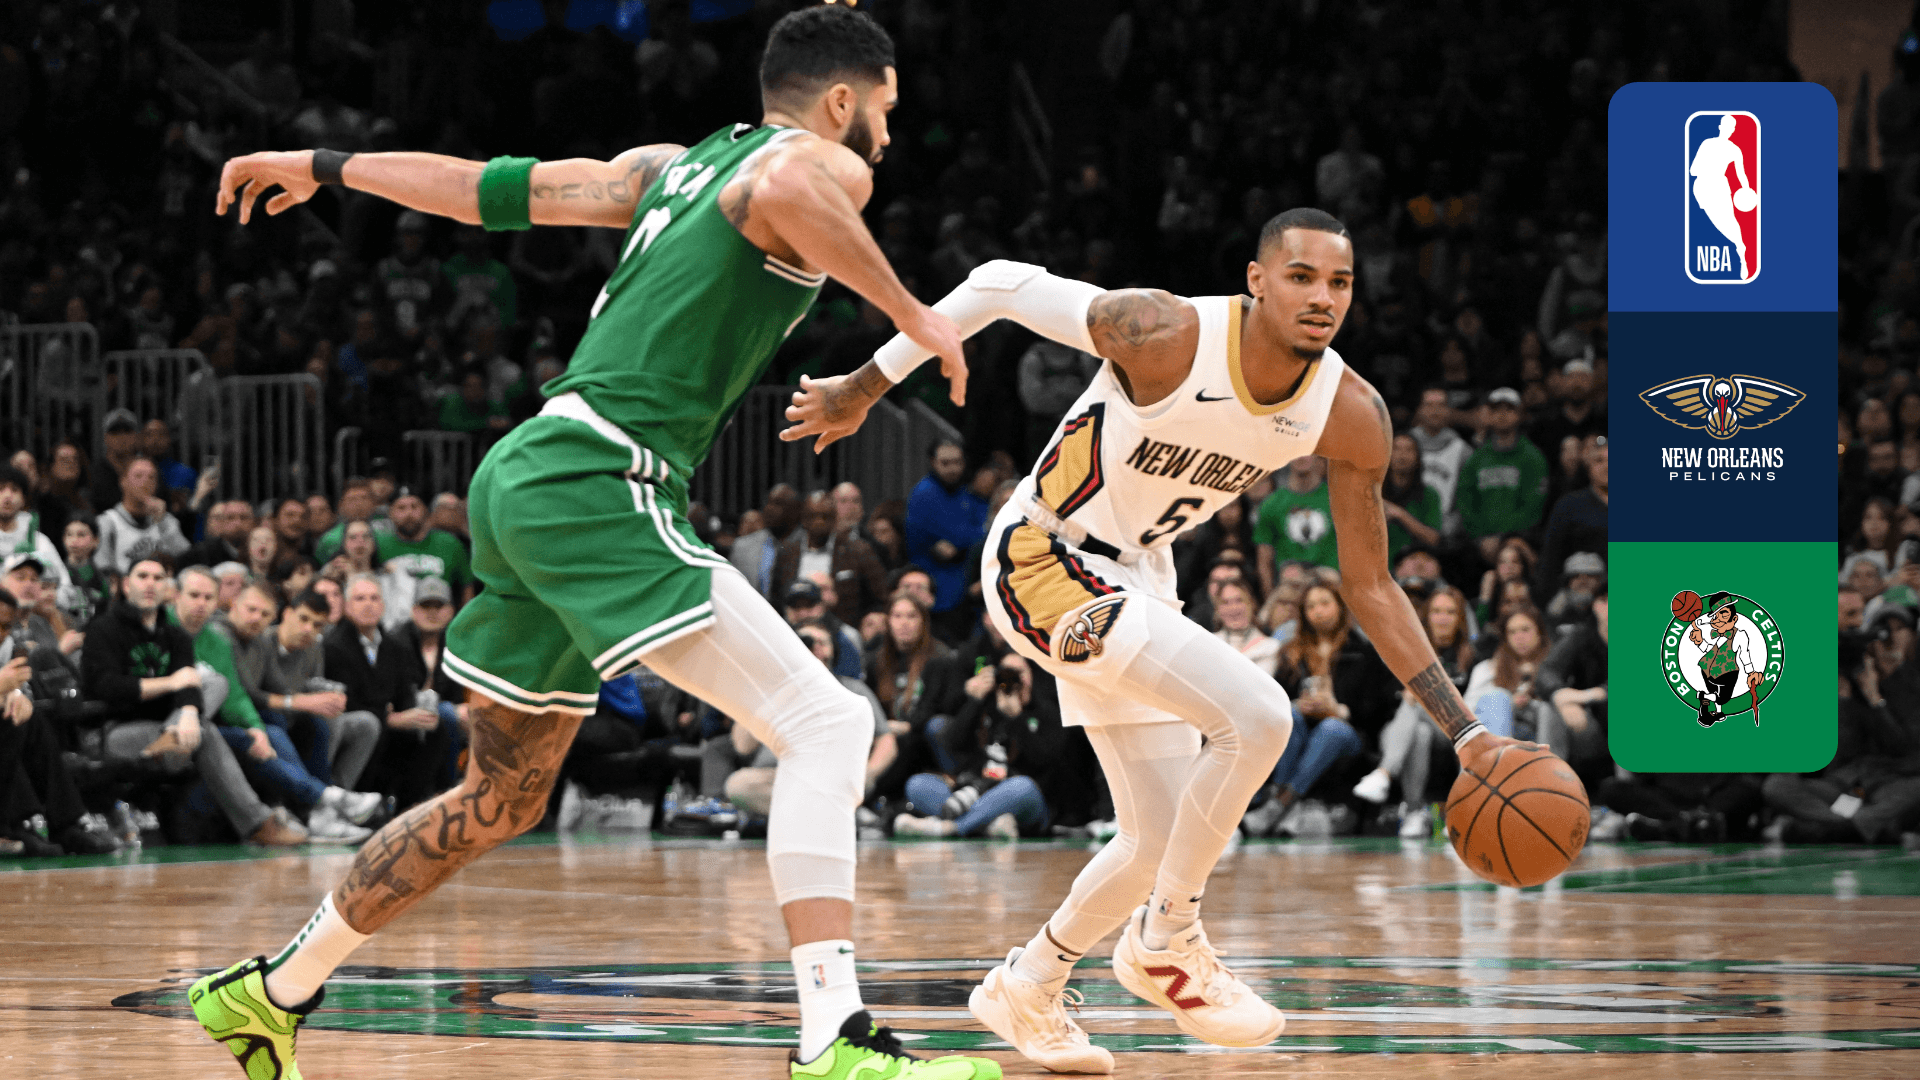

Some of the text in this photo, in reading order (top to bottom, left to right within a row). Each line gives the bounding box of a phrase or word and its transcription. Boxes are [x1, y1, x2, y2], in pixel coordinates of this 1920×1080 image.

[1125, 436, 1271, 494] NEW ORLEA
[1139, 497, 1204, 547] 5
